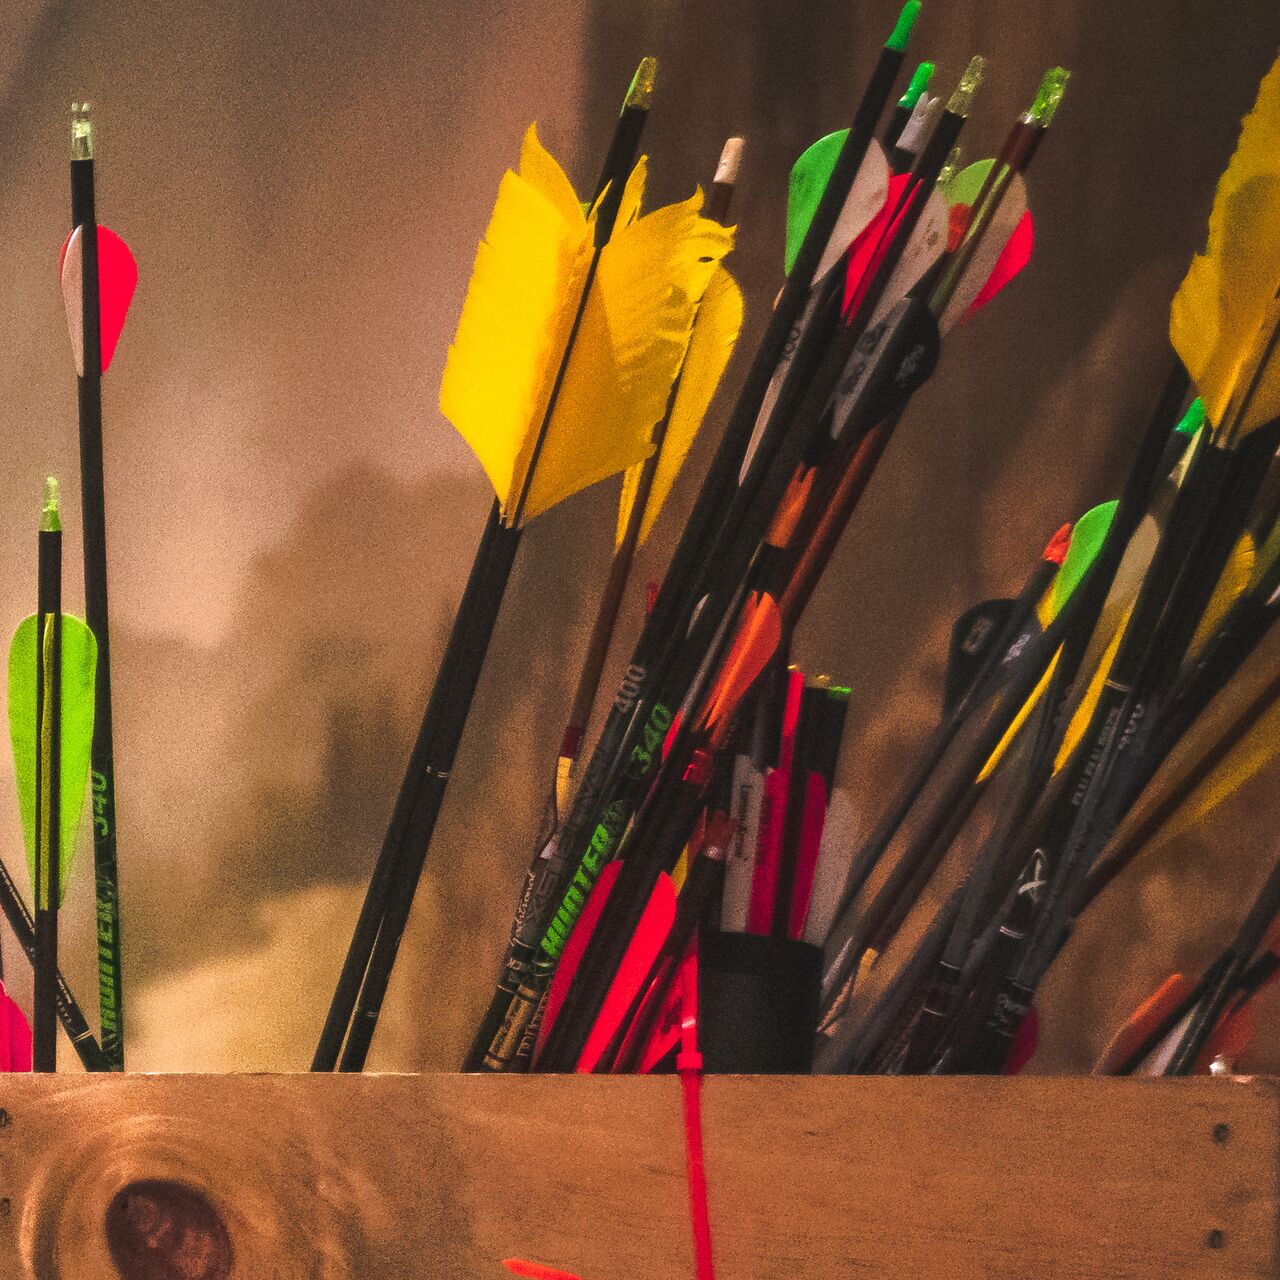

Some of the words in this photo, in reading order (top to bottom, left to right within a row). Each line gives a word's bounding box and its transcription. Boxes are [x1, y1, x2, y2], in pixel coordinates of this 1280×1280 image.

[617, 663, 646, 714] 400
[541, 823, 612, 959] HUNTER
[630, 701, 672, 775] 340
